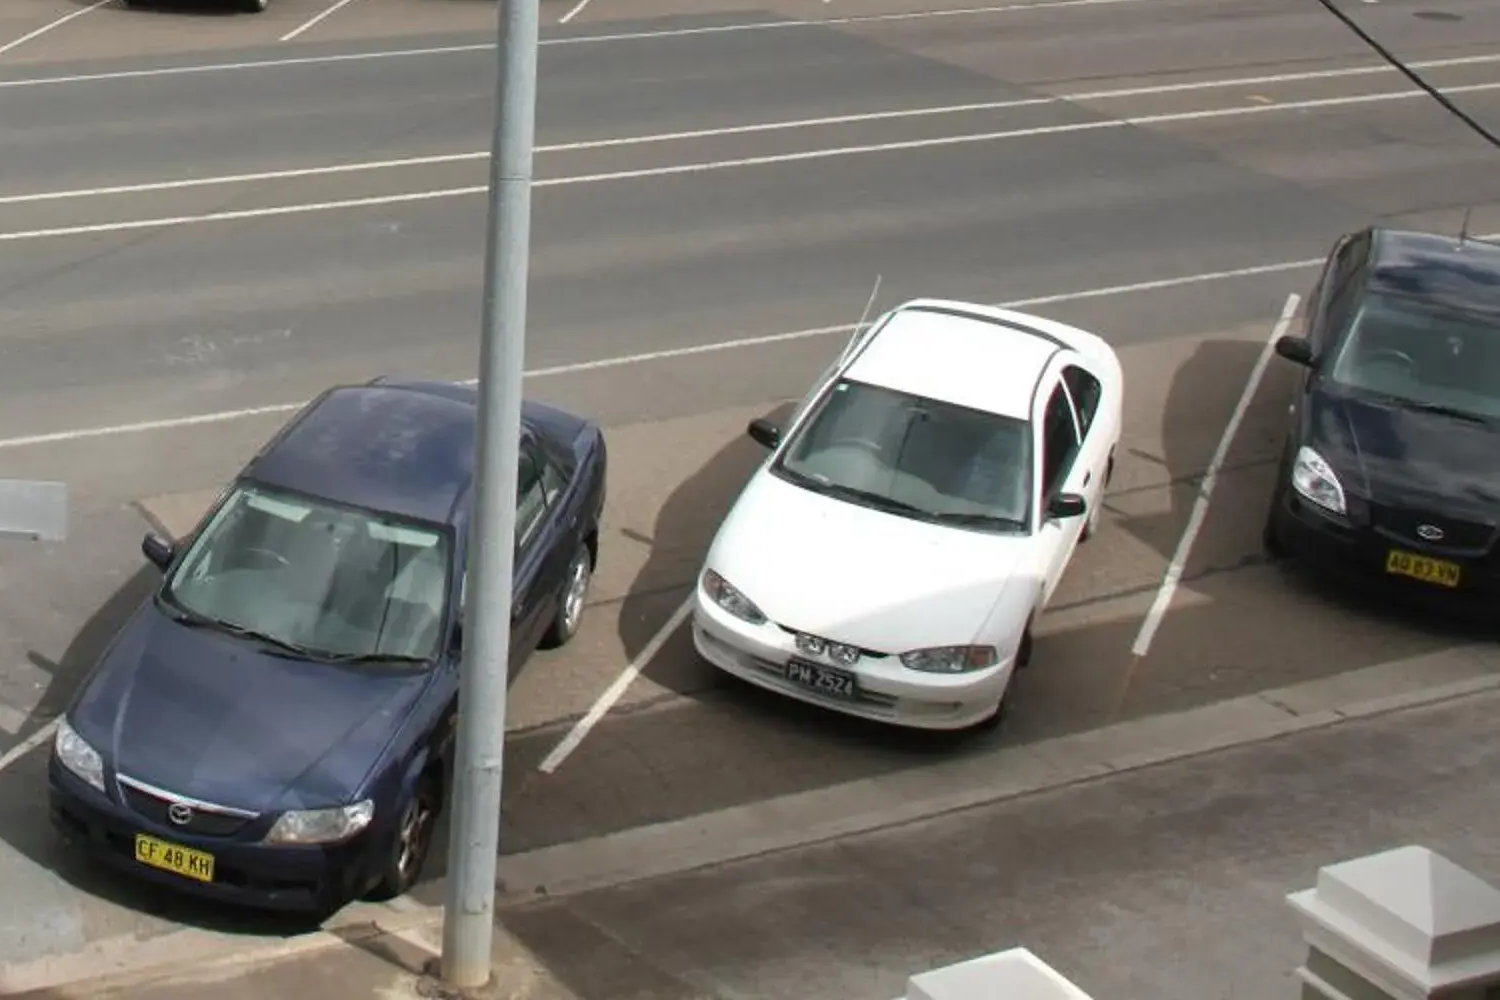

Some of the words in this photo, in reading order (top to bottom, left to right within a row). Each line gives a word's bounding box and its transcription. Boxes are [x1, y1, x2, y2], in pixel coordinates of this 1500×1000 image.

[137, 838, 158, 858] CF
[164, 847, 184, 868] 48
[189, 853, 210, 876] KH
